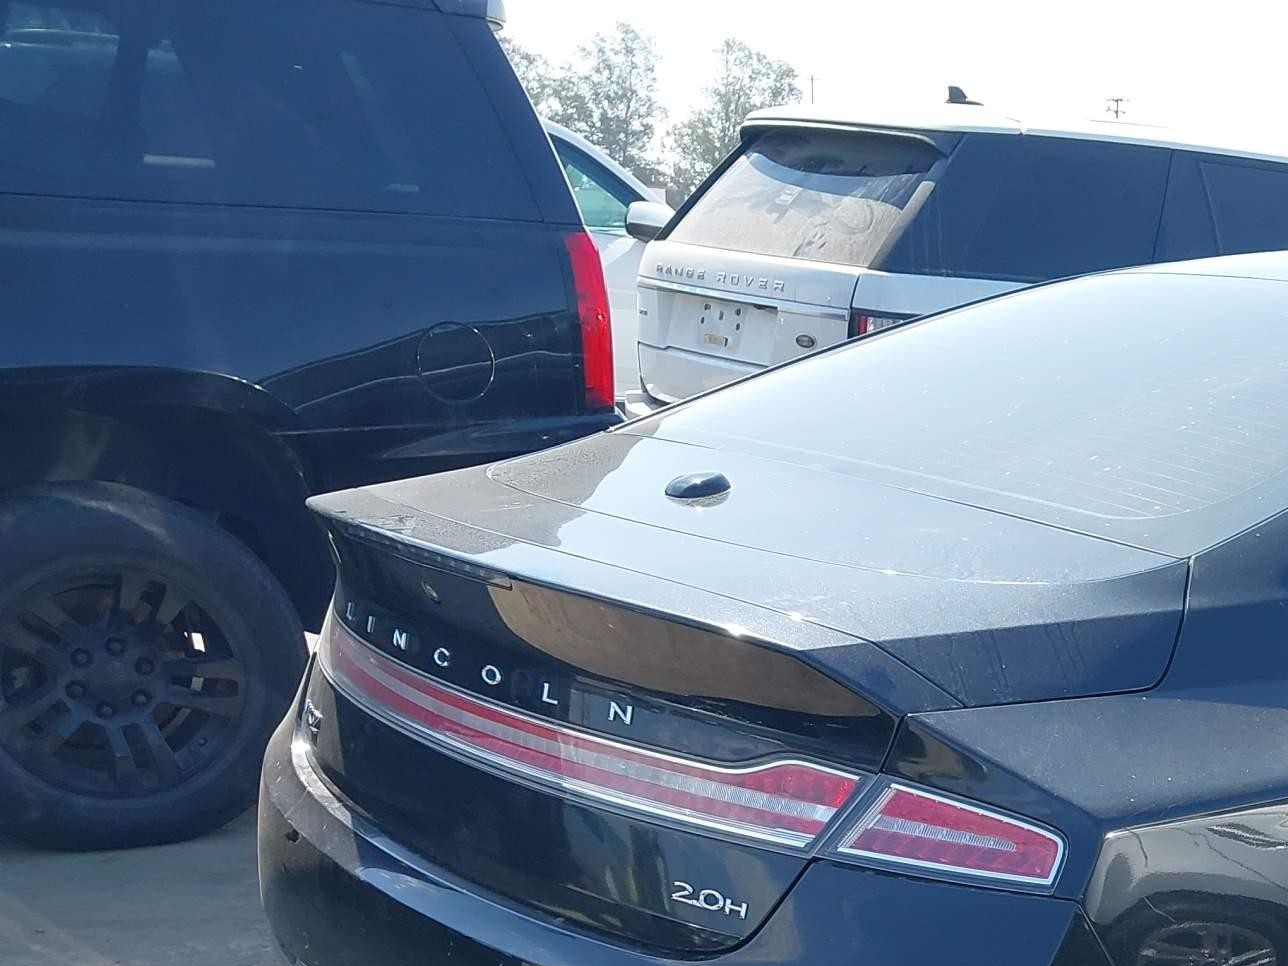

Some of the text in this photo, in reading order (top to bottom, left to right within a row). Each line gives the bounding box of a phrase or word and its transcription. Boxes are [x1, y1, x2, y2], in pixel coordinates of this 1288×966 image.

[655, 262, 785, 292] RANGE ROVER
[345, 602, 634, 725] LINCOLN
